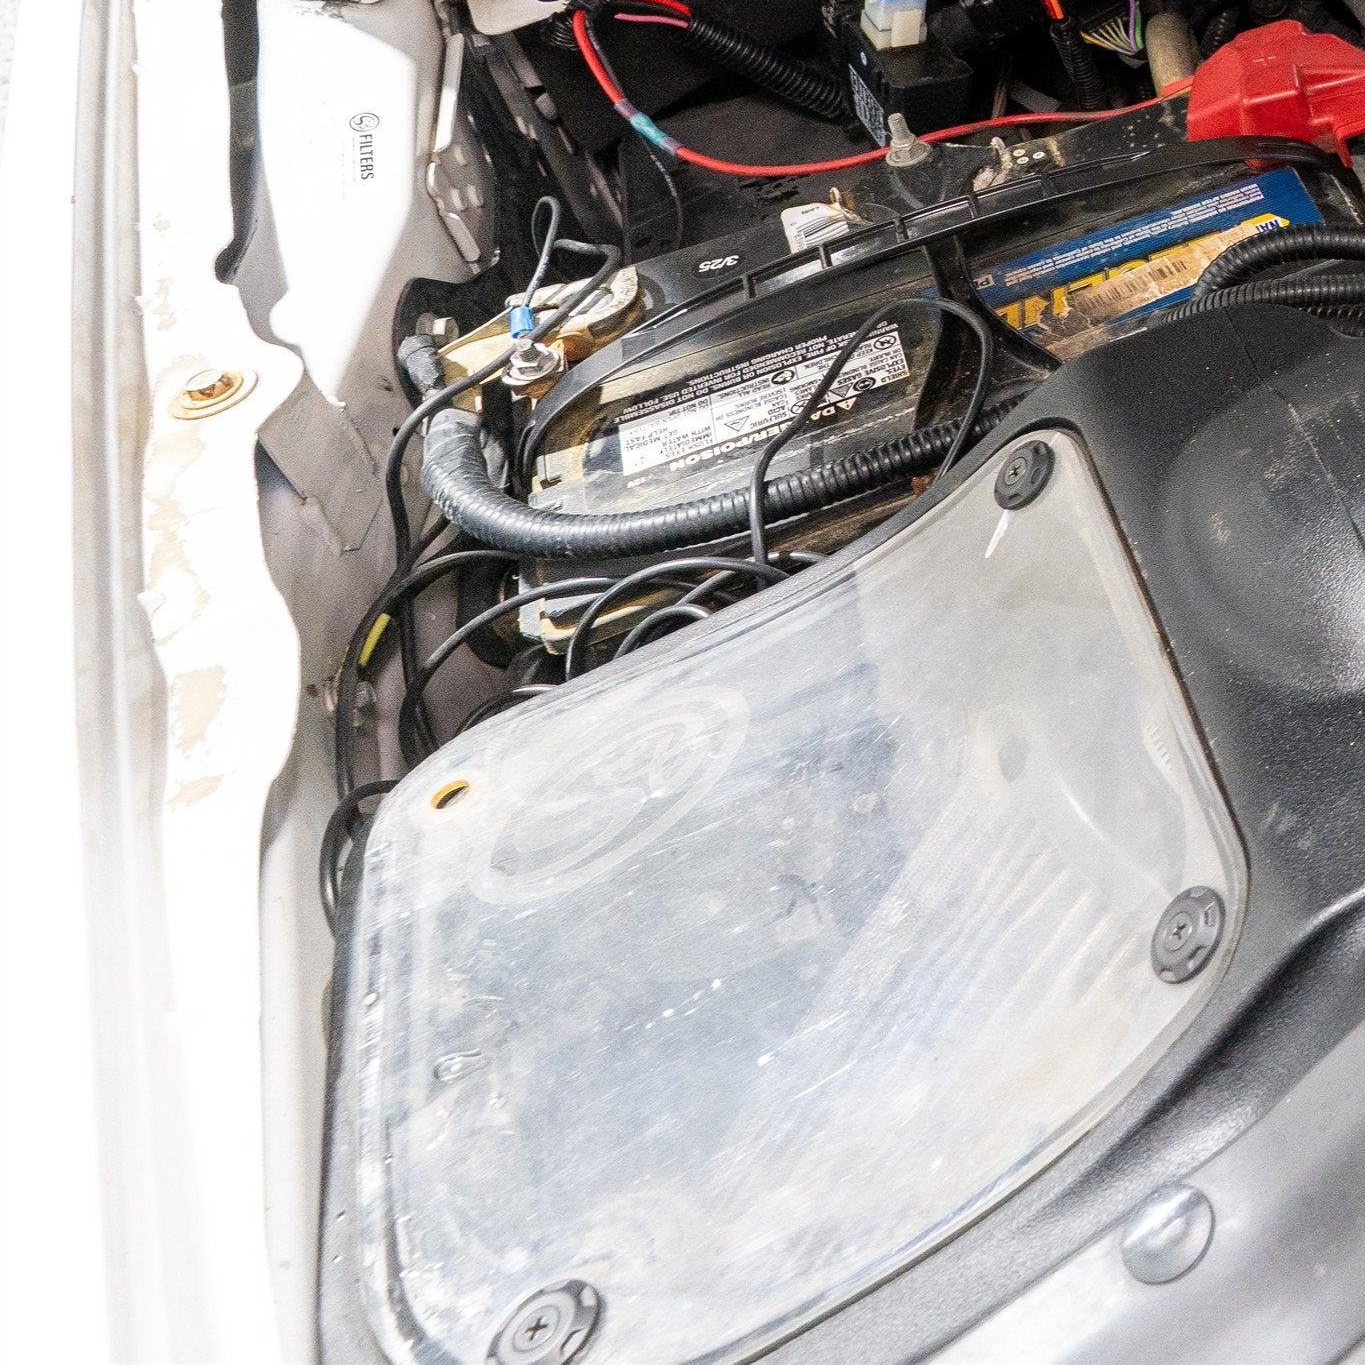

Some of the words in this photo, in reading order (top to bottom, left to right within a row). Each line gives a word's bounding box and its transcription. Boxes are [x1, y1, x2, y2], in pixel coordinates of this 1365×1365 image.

[359, 134, 374, 180] FILTERS
[697, 254, 740, 273] 3/25
[794, 334, 827, 350] PROPER
[807, 341, 825, 352] NOT
[742, 347, 806, 373] RECOMMENDED
[750, 345, 793, 364] CHARGING
[756, 354, 802, 375] EXPLOSION
[864, 357, 904, 375] EXPLOSIVE
[723, 370, 740, 380] FOR
[742, 371, 754, 379] OR
[837, 372, 862, 385] GASES
[880, 369, 908, 383] SHIELD
[680, 376, 722, 394] INVERTED
[695, 386, 709, 395] DO
[751, 382, 771, 393] READ
[675, 391, 694, 402] NOT
[613, 397, 675, 424] DISASSEMBLE
[621, 397, 658, 414] FOLLOW
[767, 404, 786, 415] ACID
[749, 411, 787, 428] SULFURIC
[668, 406, 835, 471] DAGER/POISON
